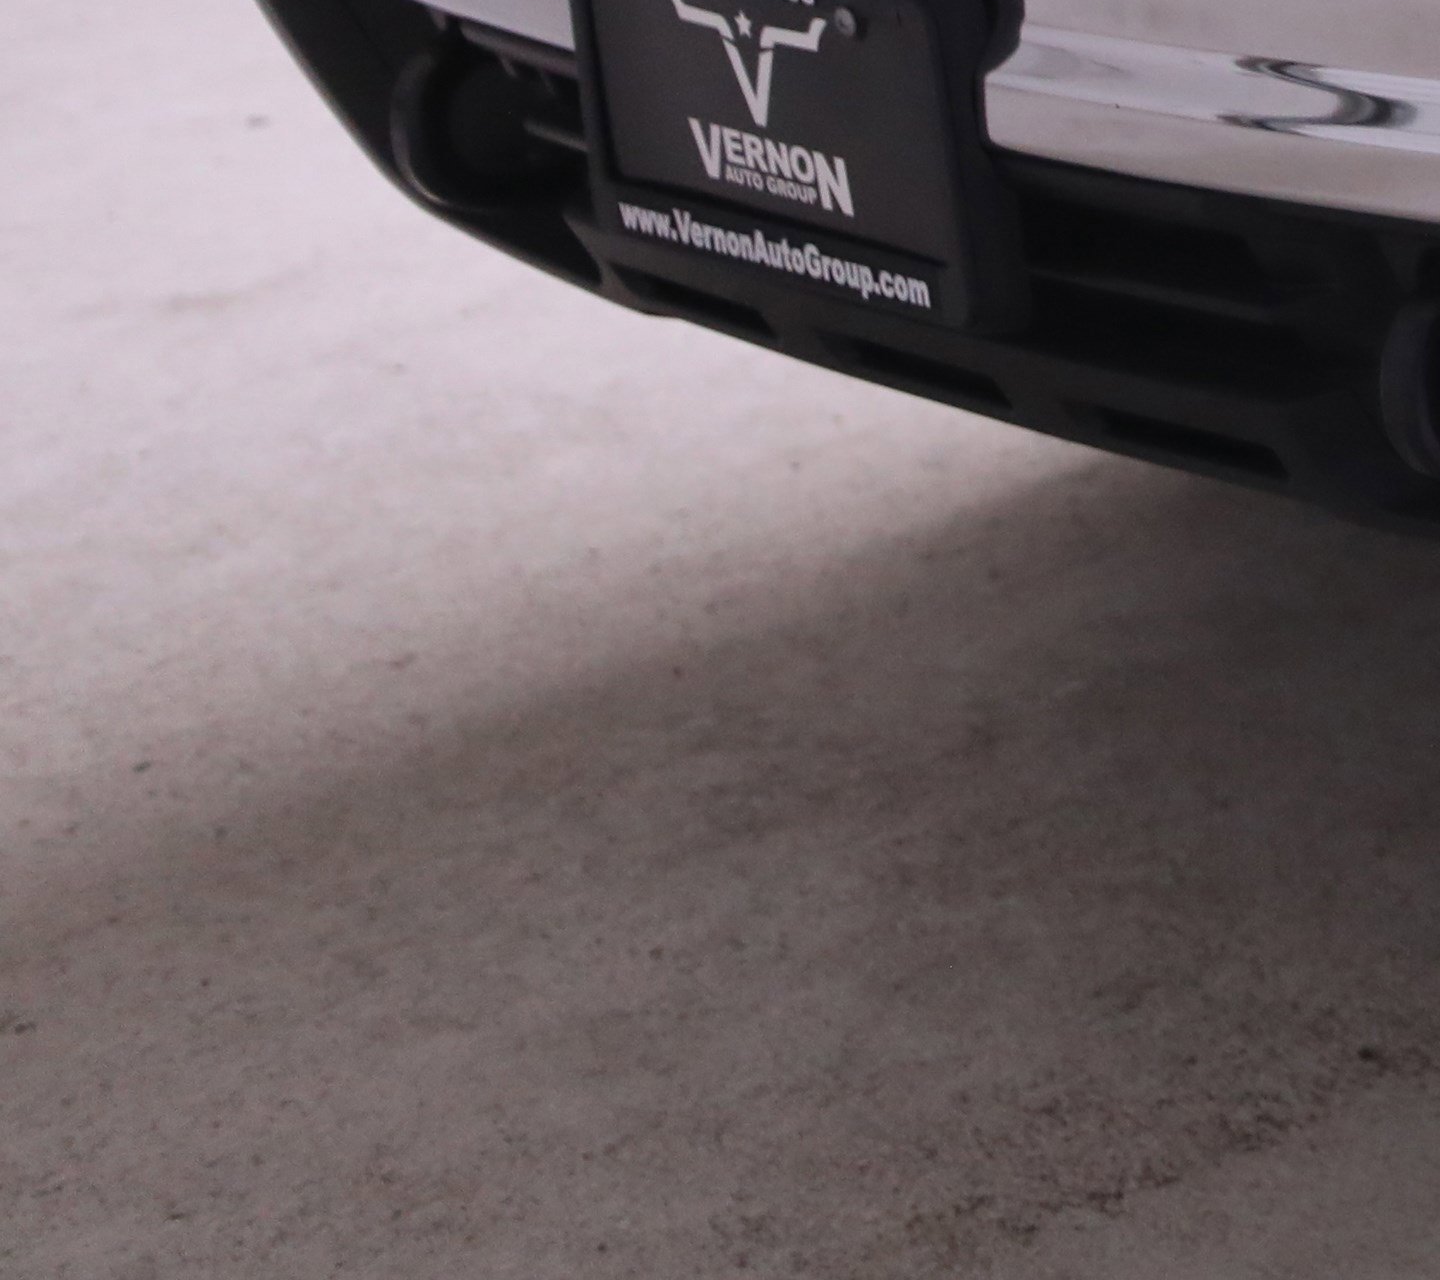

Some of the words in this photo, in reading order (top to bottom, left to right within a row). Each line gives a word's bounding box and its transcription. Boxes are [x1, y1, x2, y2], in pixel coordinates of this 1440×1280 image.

[688, 117, 854, 217] VERNON
[723, 165, 764, 191] AUTO
[766, 176, 818, 205] GROUP
[618, 201, 931, 309] www.VernonAutoGroup.com
